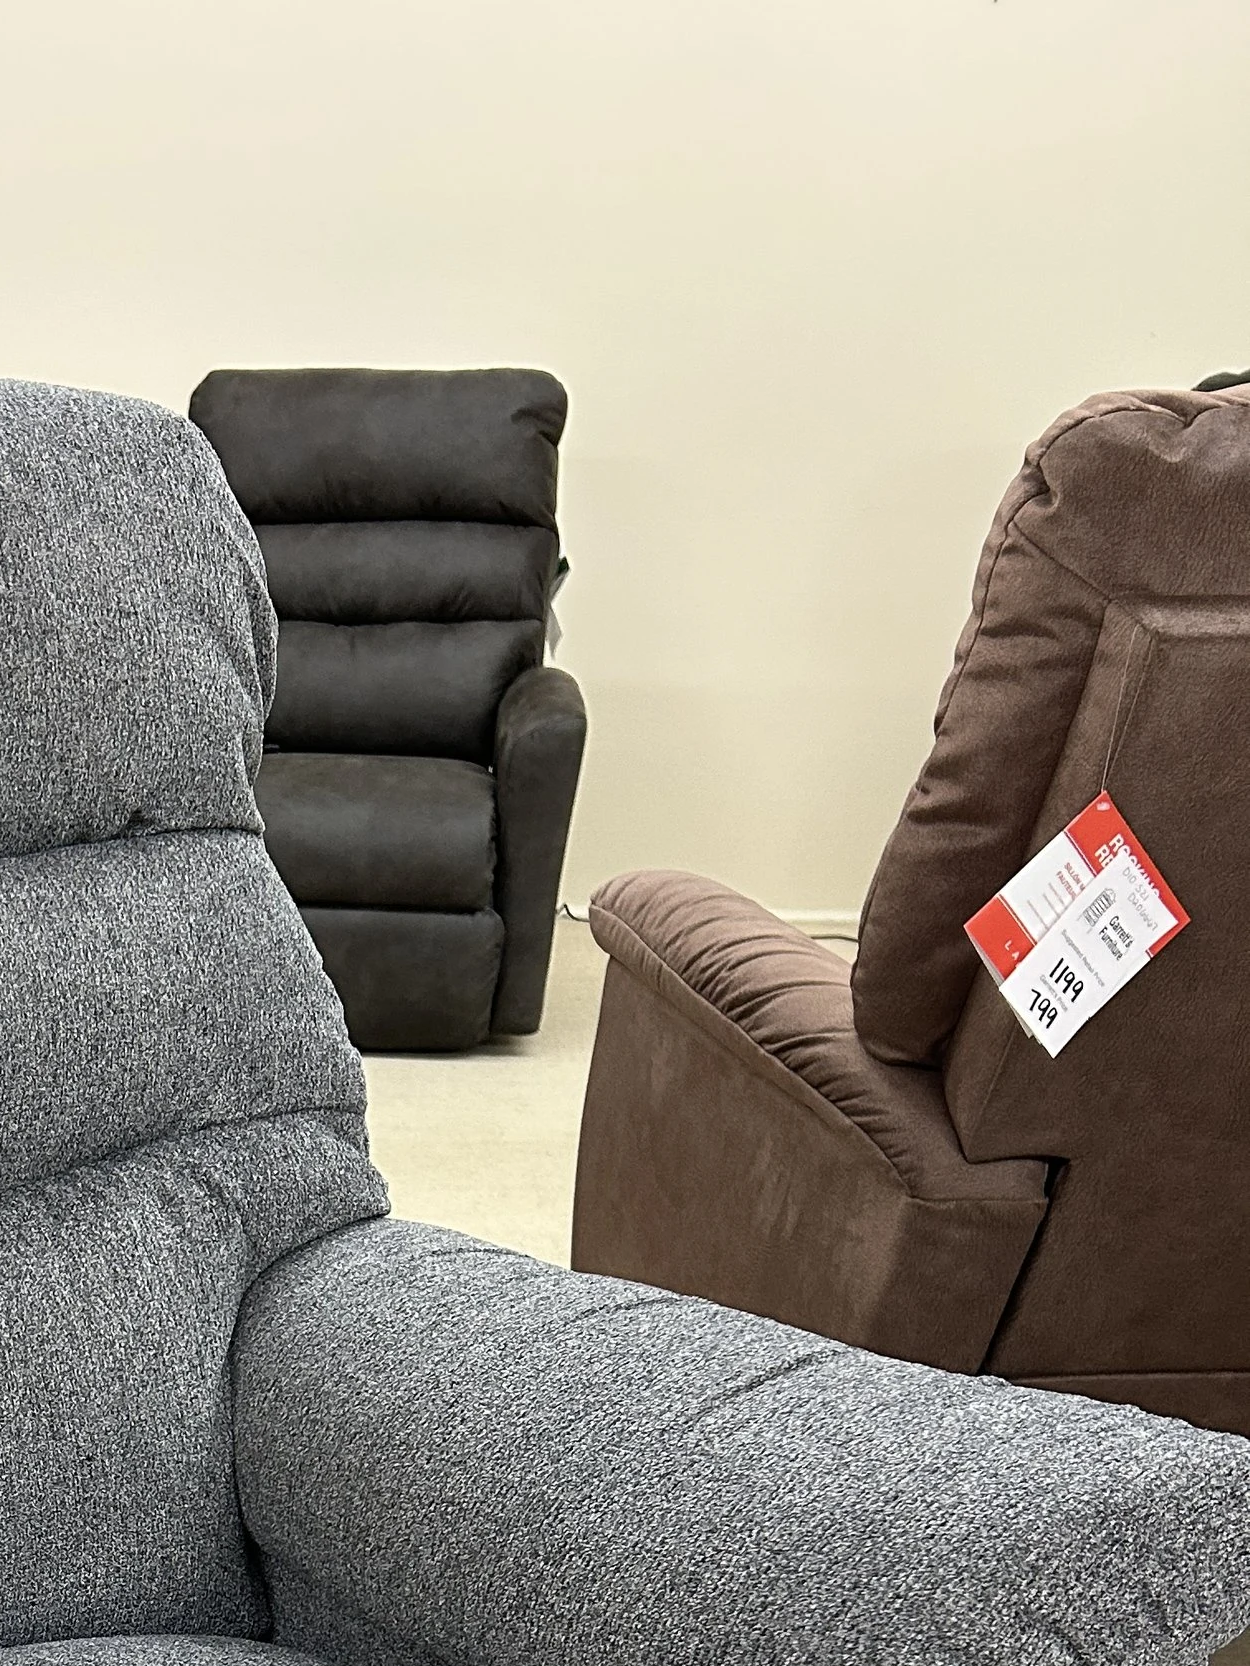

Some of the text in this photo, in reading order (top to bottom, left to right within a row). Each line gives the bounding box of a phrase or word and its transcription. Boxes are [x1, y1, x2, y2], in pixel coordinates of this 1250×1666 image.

[1098, 926, 1124, 961] Furniture
[1109, 915, 1134, 948] Garrett's
[1049, 957, 1084, 1003] 1199
[1029, 988, 1058, 1029] 799
